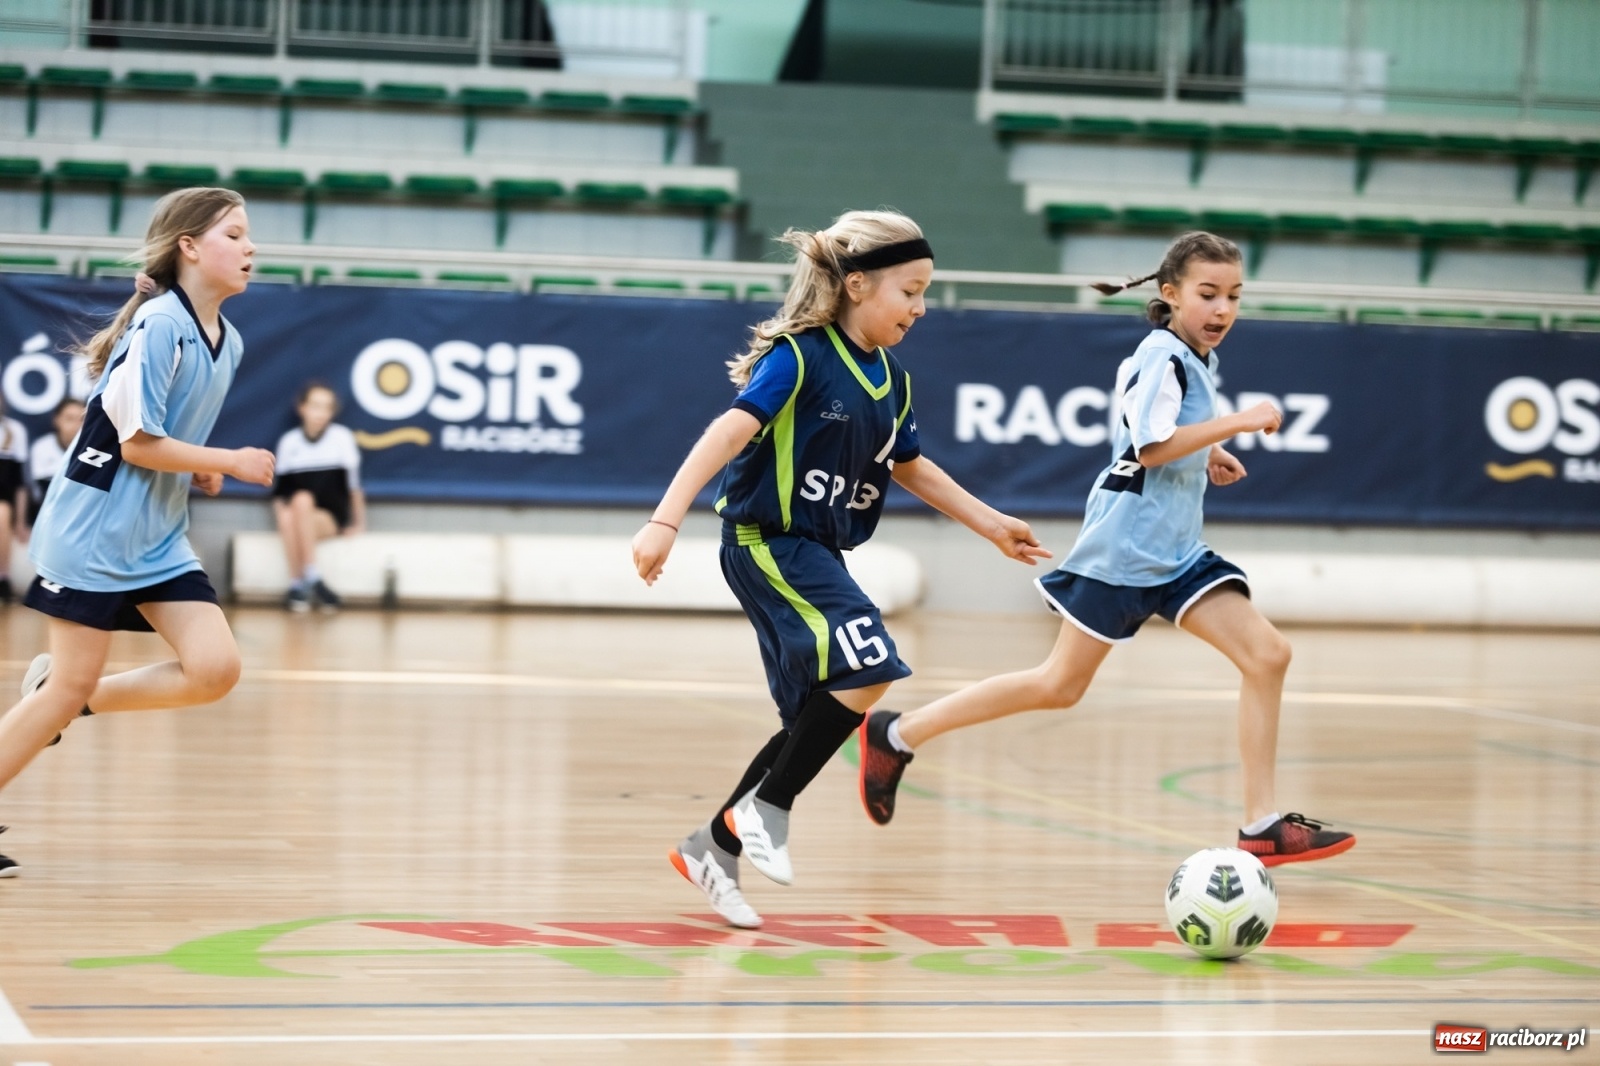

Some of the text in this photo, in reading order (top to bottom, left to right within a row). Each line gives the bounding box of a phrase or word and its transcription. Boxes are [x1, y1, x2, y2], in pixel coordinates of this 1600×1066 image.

[350, 338, 584, 426] OSiR
[955, 374, 1331, 454] RACIRZ
[800, 468, 846, 507] SP
[835, 616, 889, 671] 15
